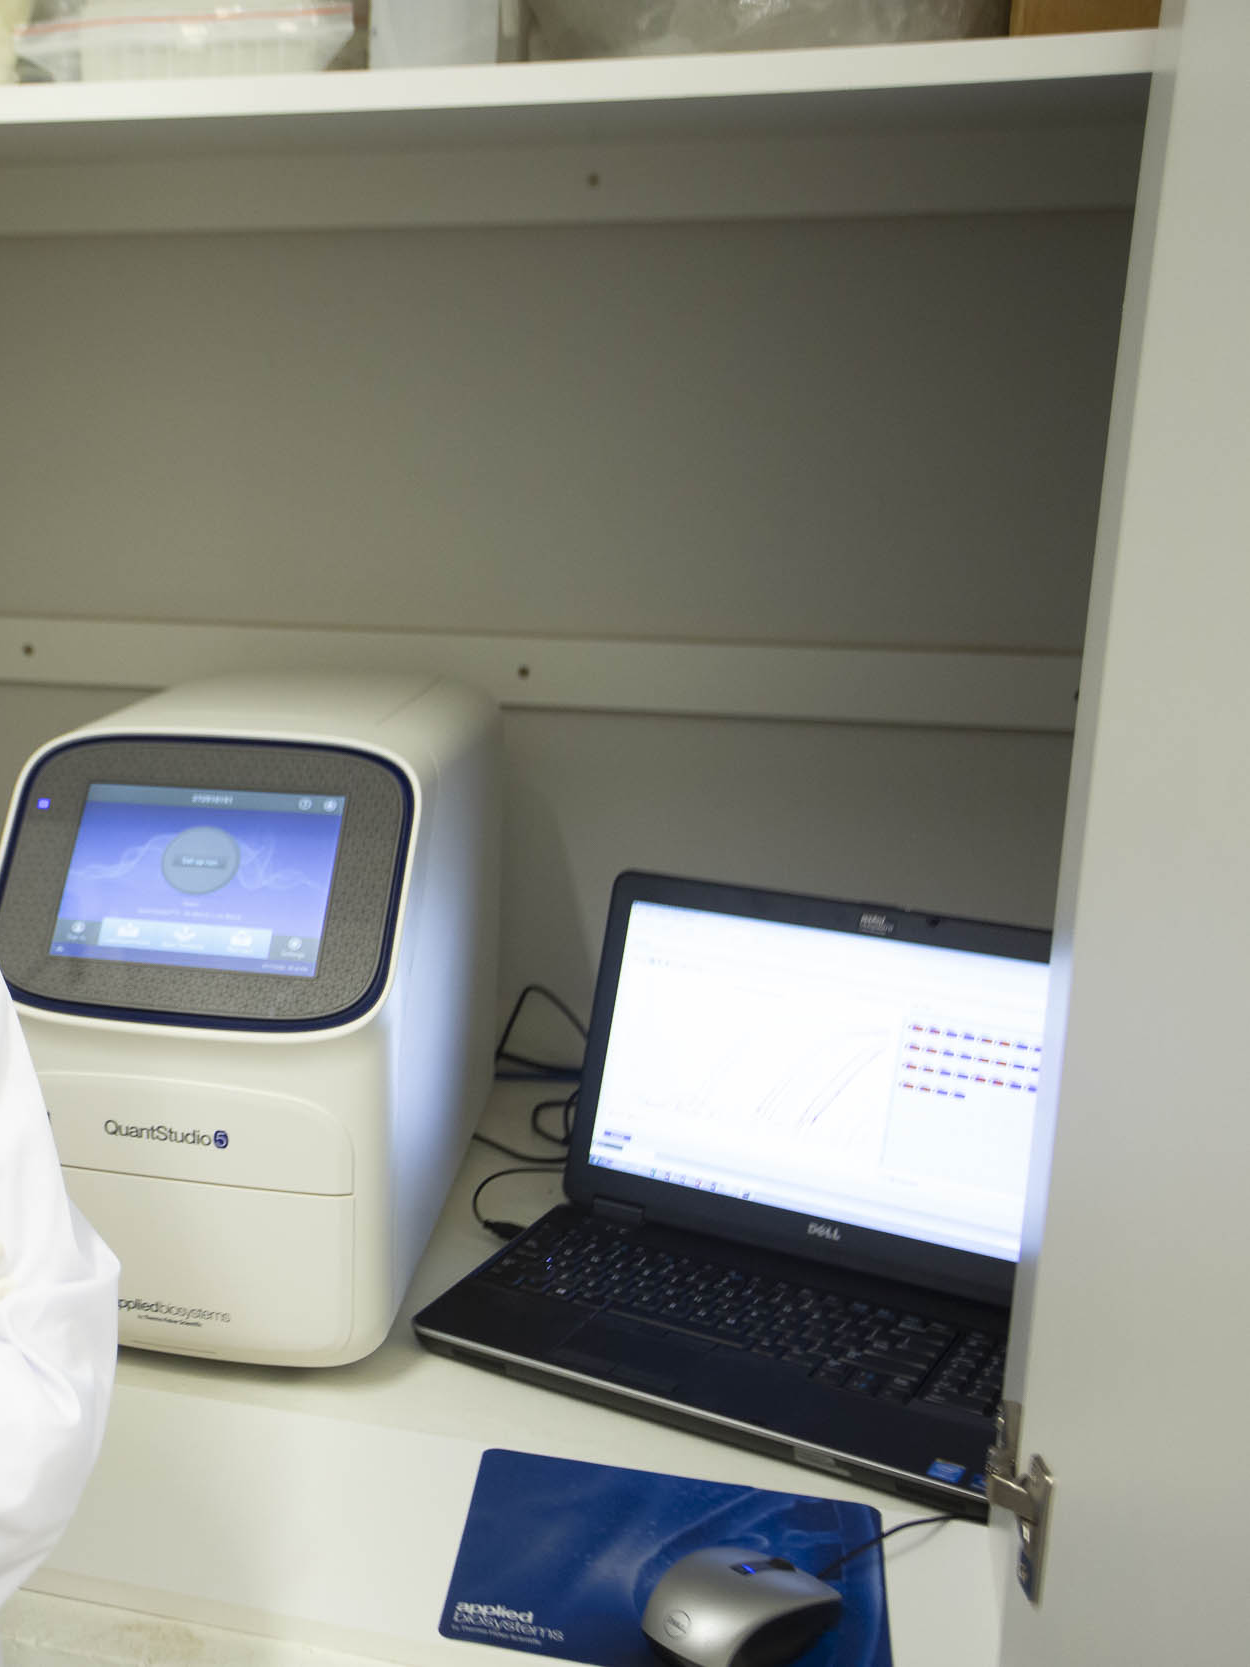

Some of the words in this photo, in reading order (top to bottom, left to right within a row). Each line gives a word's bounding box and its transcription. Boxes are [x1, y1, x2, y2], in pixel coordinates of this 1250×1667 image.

[104, 1119, 212, 1147] QuantStudio
[213, 1129, 229, 1149] 5
[806, 1222, 840, 1240] DELL
[455, 1601, 533, 1623] applied
[453, 1610, 564, 1641] biosystems
